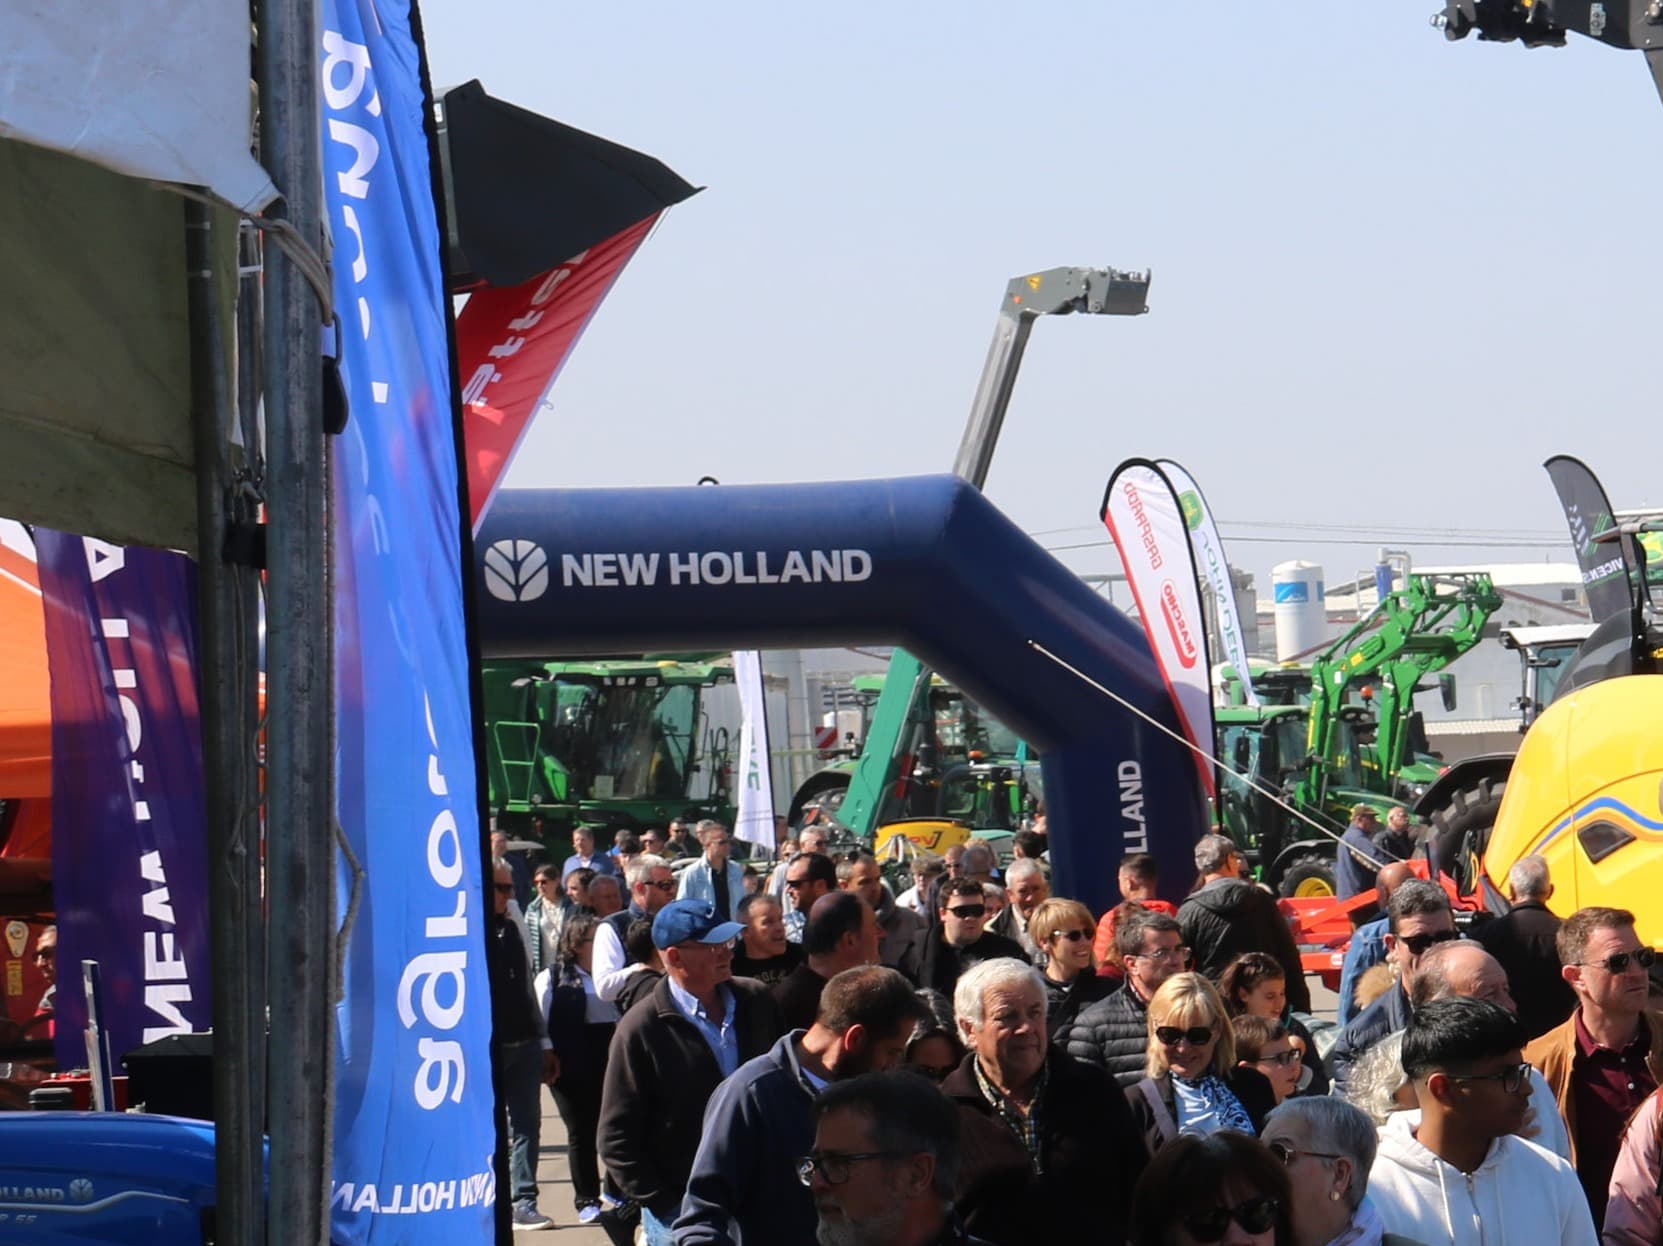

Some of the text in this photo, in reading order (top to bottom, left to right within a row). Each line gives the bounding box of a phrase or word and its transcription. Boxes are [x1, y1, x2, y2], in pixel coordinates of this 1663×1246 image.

[561, 549, 873, 587] NEW HOLLAND
[1117, 760, 1148, 853] LLAND
